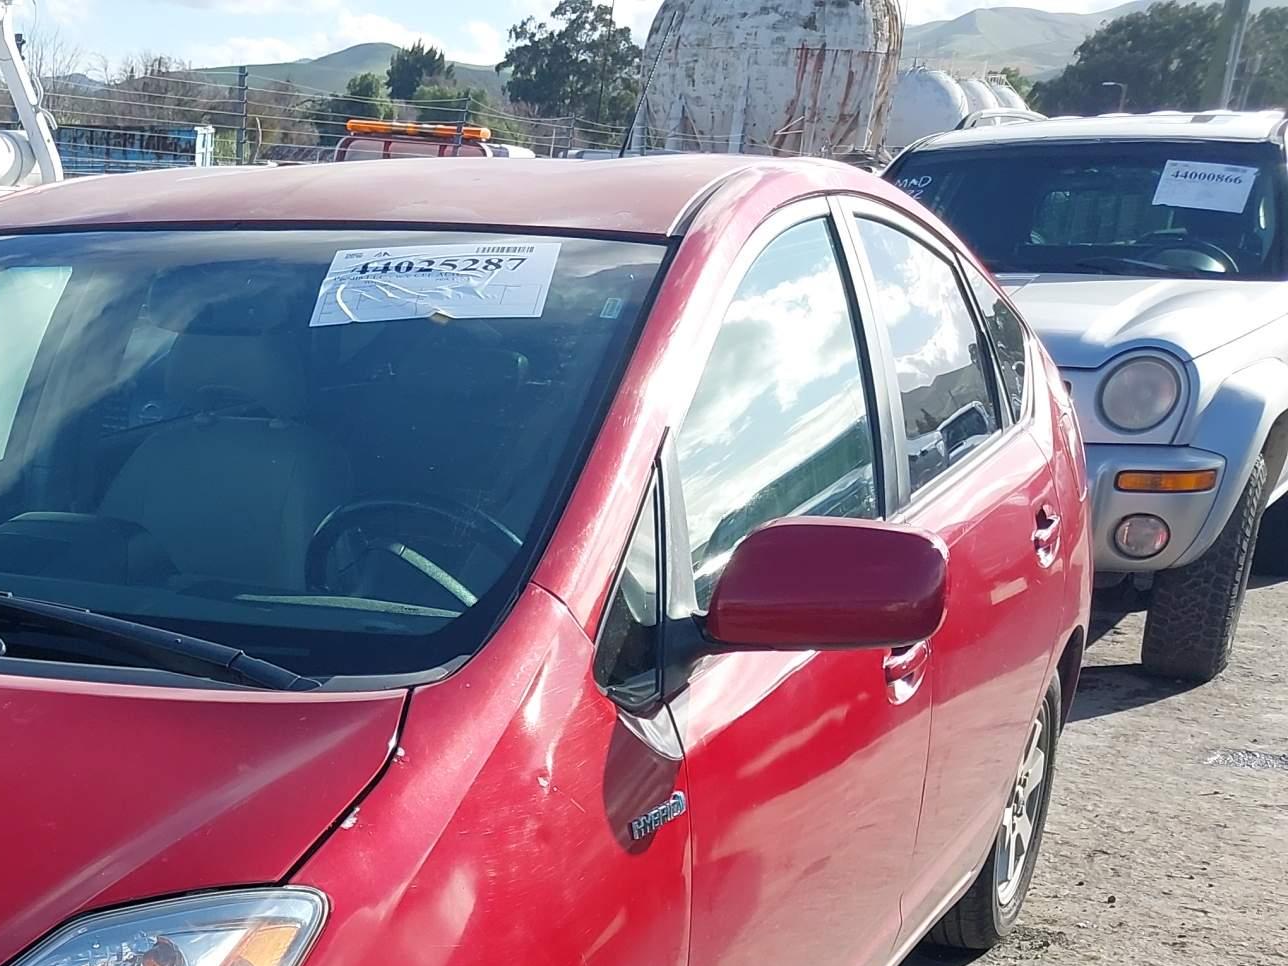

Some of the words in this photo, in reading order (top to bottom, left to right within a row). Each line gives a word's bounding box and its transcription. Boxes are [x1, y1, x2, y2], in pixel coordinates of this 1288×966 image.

[1171, 170, 1243, 185] 44000866
[349, 257, 528, 275] 44025287
[631, 791, 686, 840] HYBRID
